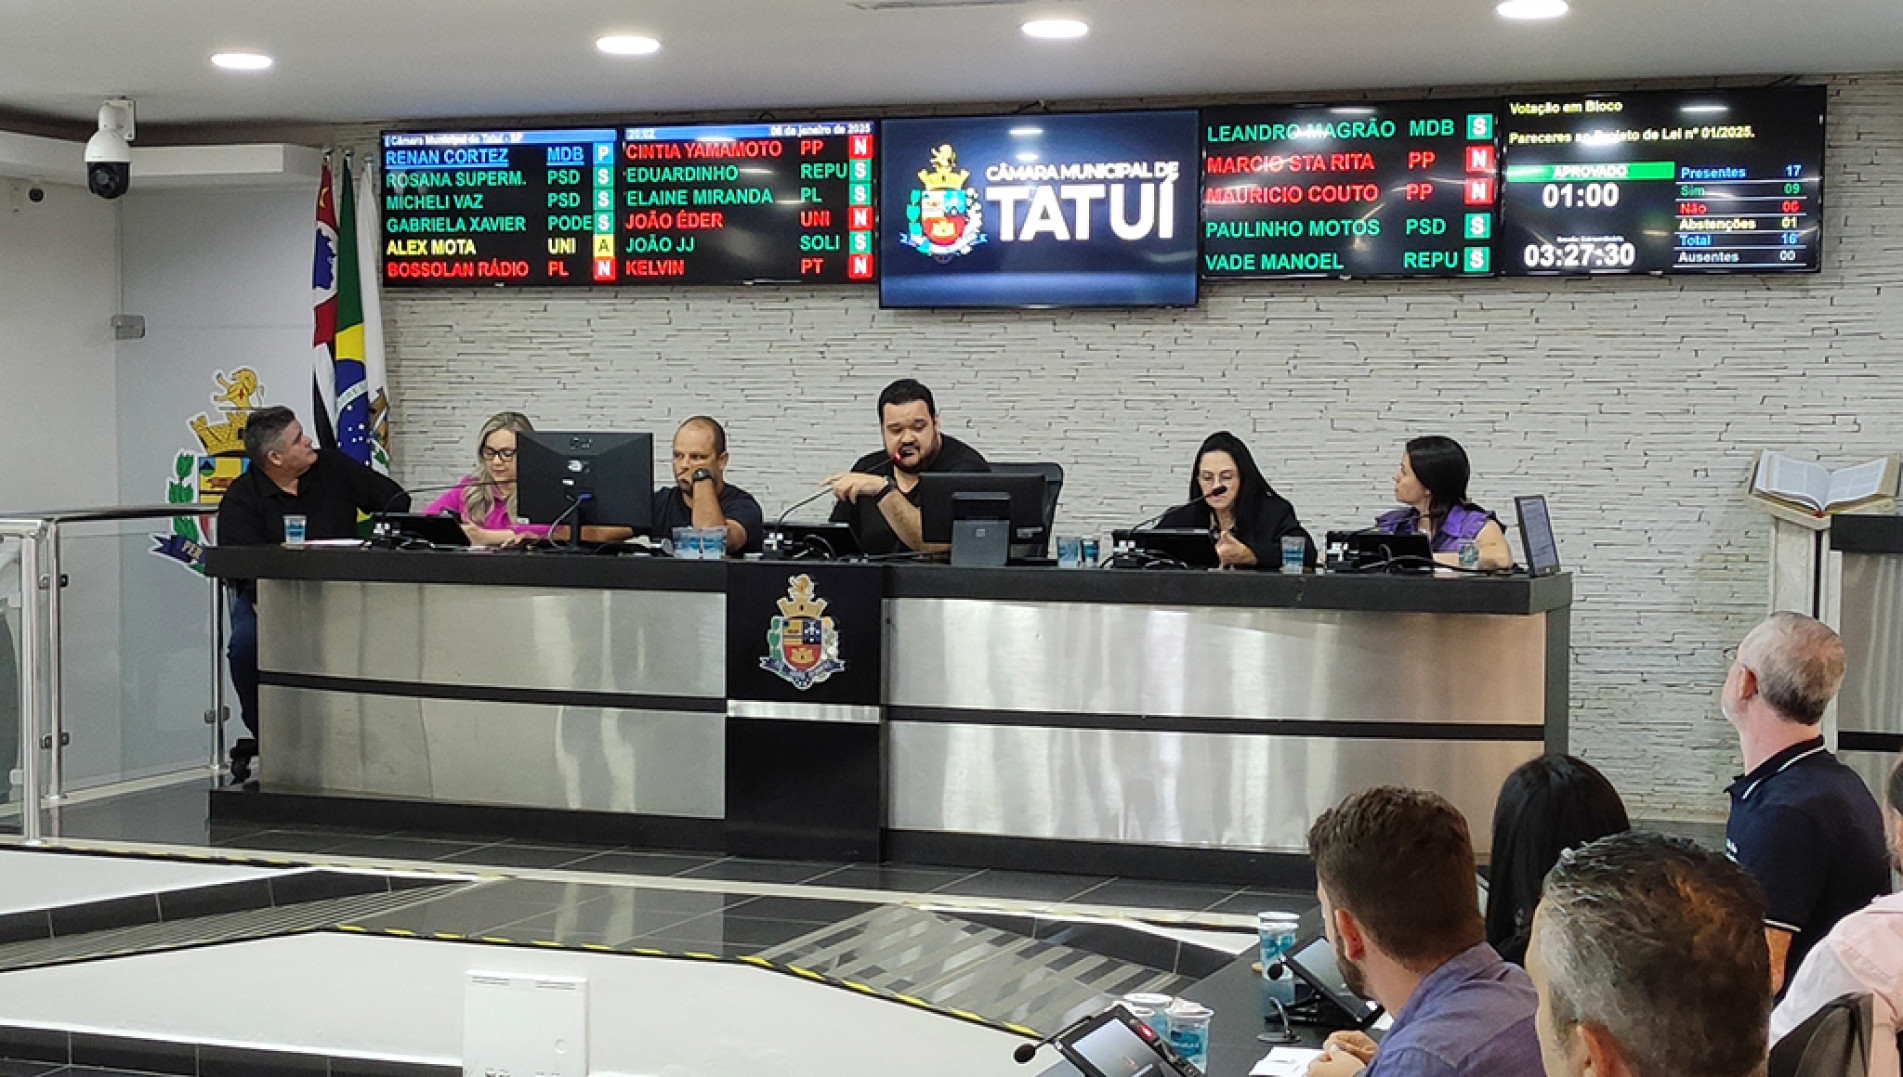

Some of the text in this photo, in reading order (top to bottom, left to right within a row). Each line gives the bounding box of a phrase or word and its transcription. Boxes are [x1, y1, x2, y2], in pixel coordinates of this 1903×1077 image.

[1510, 100, 1623, 116] Votação em Bloco
[1207, 117, 1487, 142] LEANDRO MAGRÃO MDB S
[1509, 132, 1572, 145] Pareceres
[1643, 128, 1659, 141] de
[1662, 127, 1682, 140] Lei
[1702, 126, 1755, 139] 01/2025.
[385, 146, 608, 165] RENAN CORTEZ MDB P
[625, 139, 866, 160] CINTIA YAMAMOTO PP N
[985, 161, 1180, 182] CÂMARA MUNICIPAL DE
[1206, 150, 1487, 174] MARCIO STA RITA PP N
[1553, 164, 1628, 179] APROVADO
[386, 169, 608, 188] ROSANA SUPERM. PSD S
[626, 162, 866, 183] EDUARDINHO REPU S
[1681, 165, 1801, 179] Presentes 17
[626, 187, 866, 206] ELAINE MIRANDA PL S
[1206, 182, 1486, 205] MAURICIO COUTO PP N
[1542, 182, 1620, 209] 01:00
[1681, 183, 1800, 196] Sim 09
[386, 192, 609, 210] MICHELI VAZ PSD S
[985, 175, 1178, 241] TATUÍ
[1680, 201, 1707, 215] Não
[386, 215, 609, 232] GABRIELA XAVIER PODE S
[625, 210, 866, 229] JOÃO ÉDER UNI N
[1205, 217, 1484, 238] PAULINHO MOTOS PSD S
[1680, 217, 1798, 232] Abstenções 01
[386, 237, 610, 256] ALEX MOTA UNI A
[625, 234, 866, 253] JOÃO JJ SOLI S
[1680, 233, 1798, 246] Total 16
[1205, 251, 1484, 271] VADE MANOEL REPU S
[1524, 242, 1636, 267] 03:27:30
[1678, 250, 1796, 263] Ausentes 00
[387, 262, 474, 278] BOSSOLAN
[477, 258, 529, 277] RÁDIO
[597, 260, 610, 276] N
[625, 258, 866, 276] KELVIN PT N
